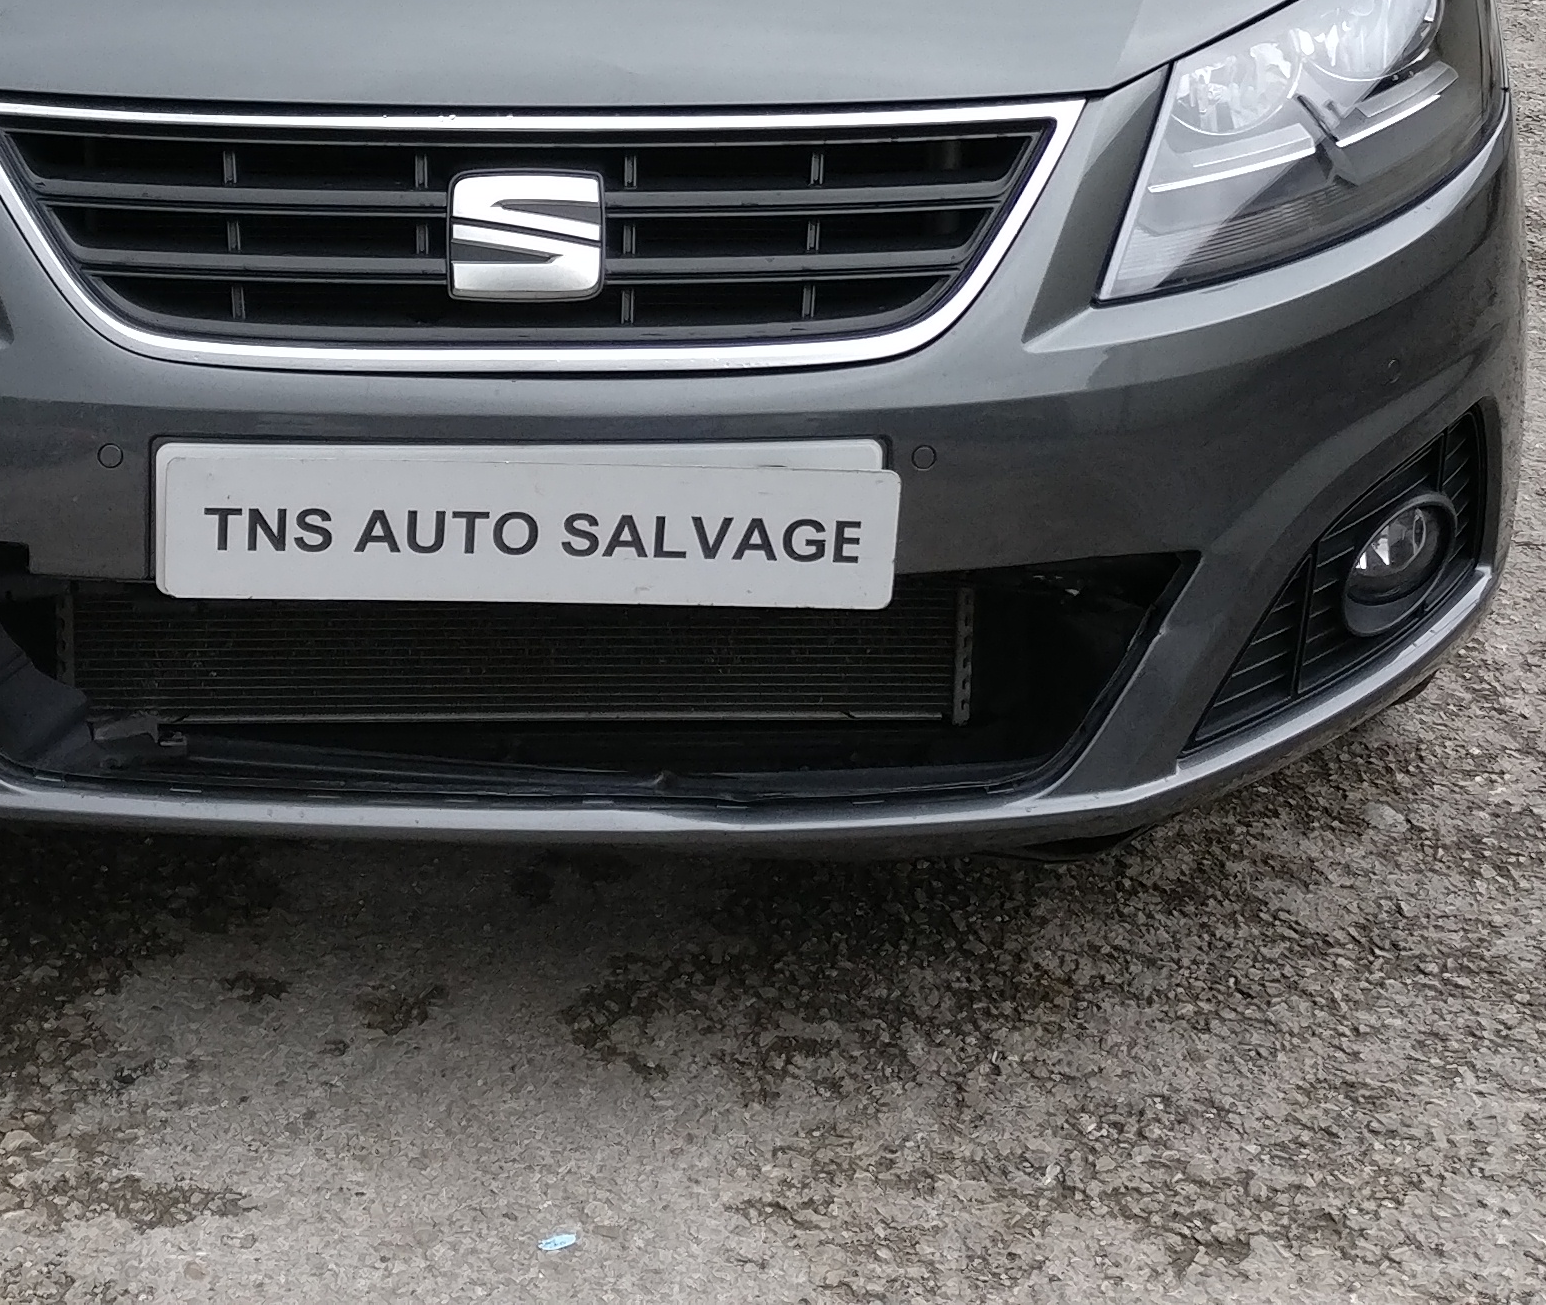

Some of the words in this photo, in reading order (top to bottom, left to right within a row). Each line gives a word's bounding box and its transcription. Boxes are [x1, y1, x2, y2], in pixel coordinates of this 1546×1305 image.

[203, 507, 333, 553] TNS
[353, 509, 540, 555] AUTO
[560, 512, 863, 564] SALVAGE
